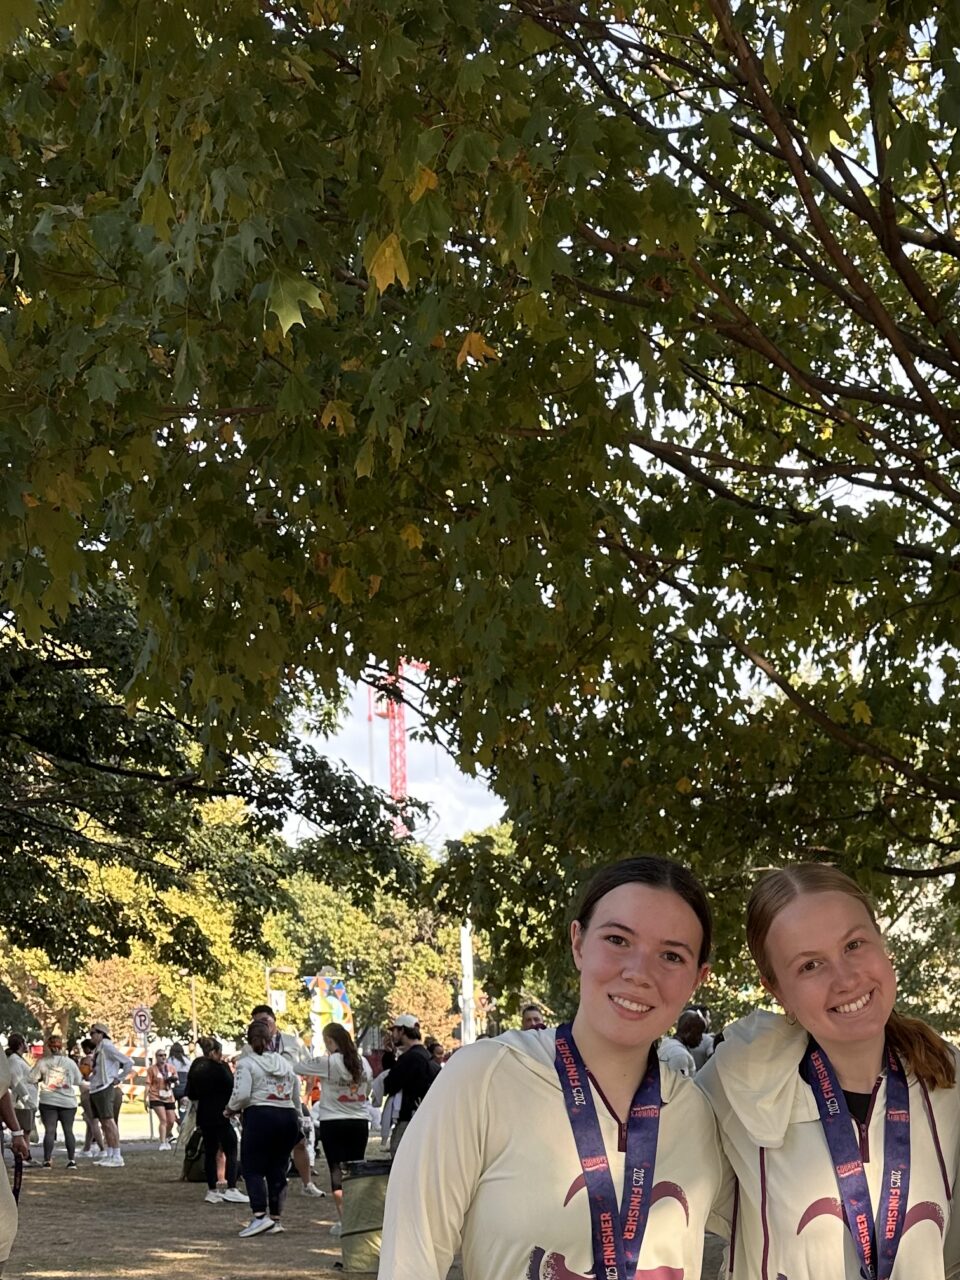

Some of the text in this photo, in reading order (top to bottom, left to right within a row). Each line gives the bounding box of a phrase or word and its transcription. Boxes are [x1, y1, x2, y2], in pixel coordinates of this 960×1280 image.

[556, 1037, 586, 1106] 2025 FINISHER
[810, 1050, 840, 1115] 2025 FINISHER
[623, 1167, 645, 1240] 2025 FINISHER
[885, 1170, 902, 1240] 2025 FINISHER
[600, 1212, 617, 1266] FINISHER
[856, 1212, 872, 1265] FINISHER
